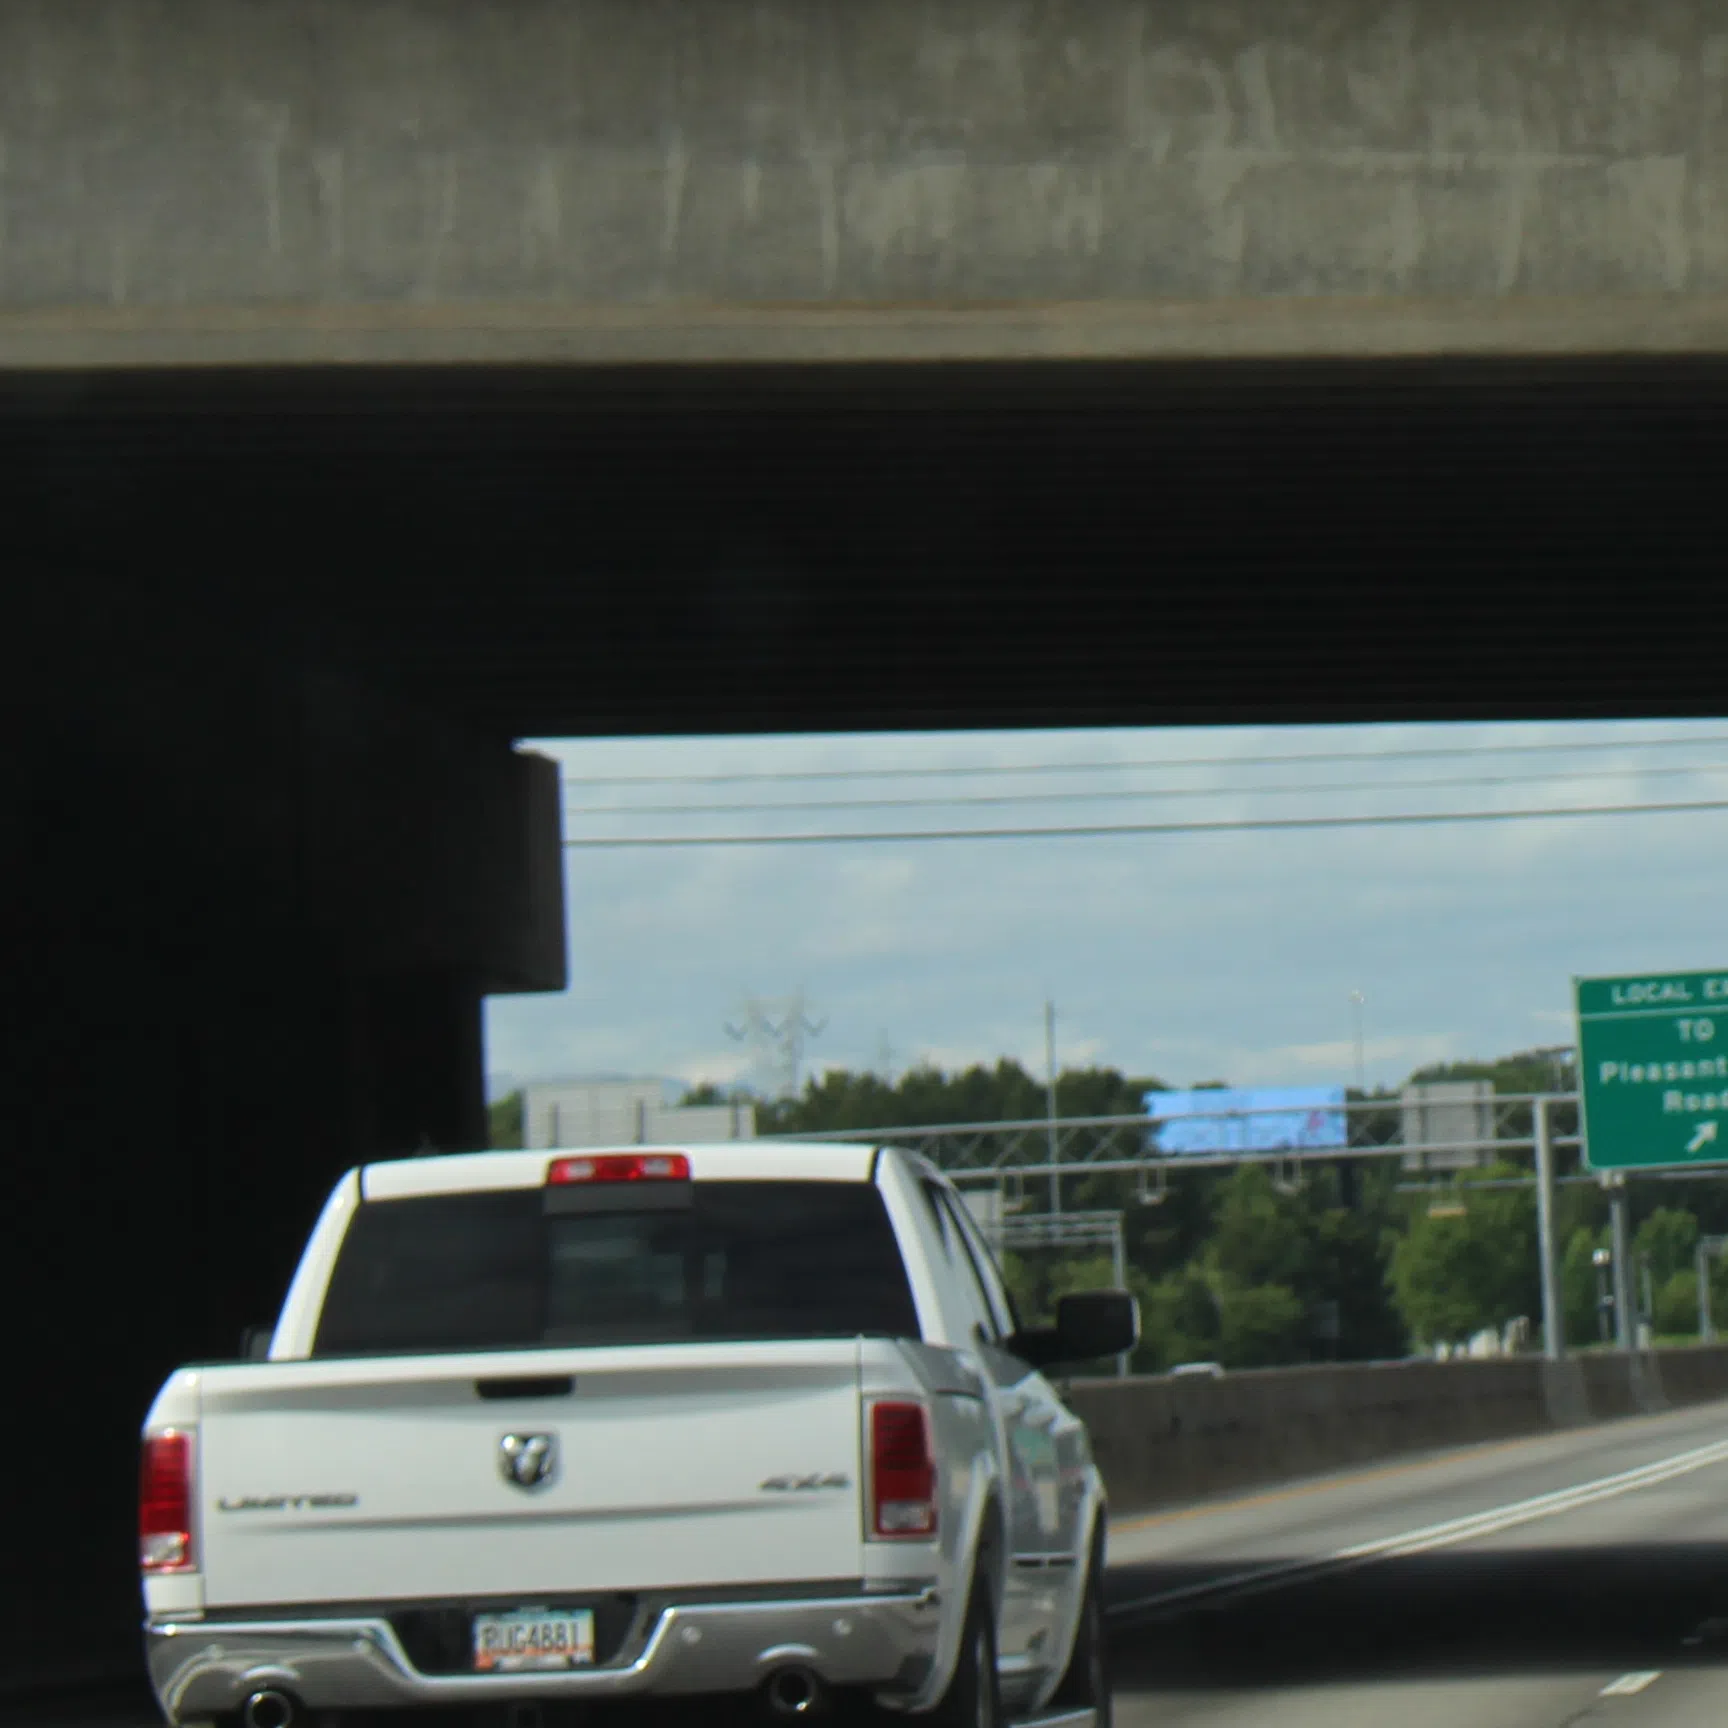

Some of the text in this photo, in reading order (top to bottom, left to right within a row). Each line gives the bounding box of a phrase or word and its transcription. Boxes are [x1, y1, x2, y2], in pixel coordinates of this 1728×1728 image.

[1611, 981, 1693, 1006] LOCAL
[1676, 1018, 1715, 1042] TO
[1600, 1055, 1728, 1085] Pleasant
